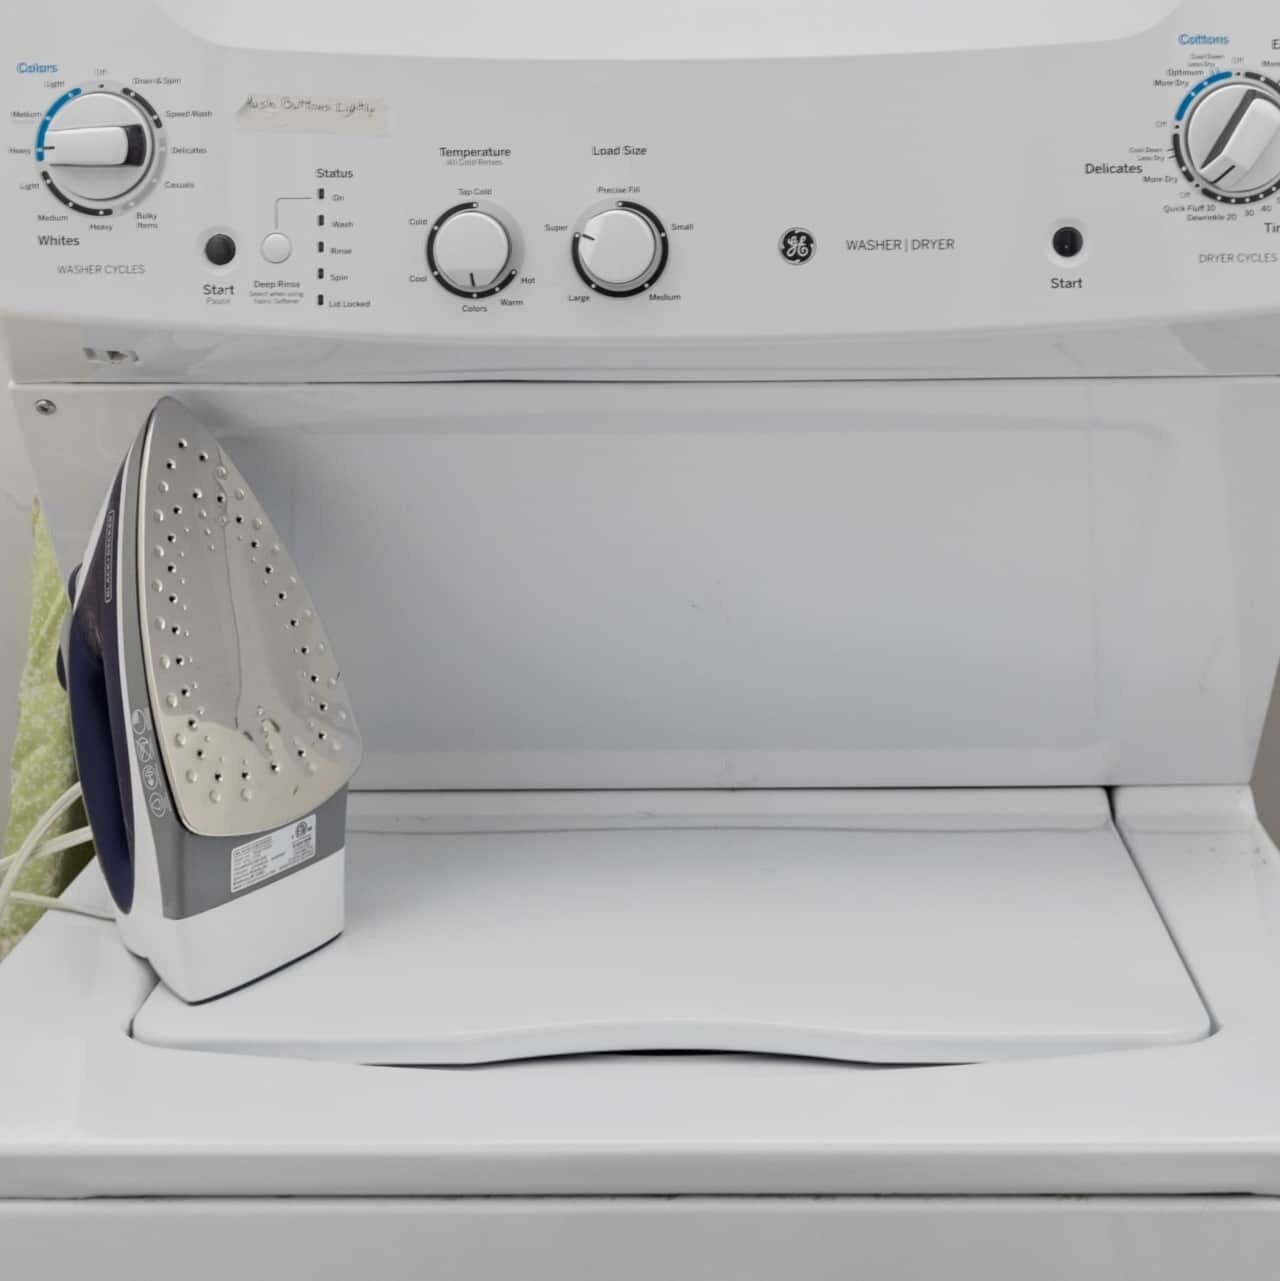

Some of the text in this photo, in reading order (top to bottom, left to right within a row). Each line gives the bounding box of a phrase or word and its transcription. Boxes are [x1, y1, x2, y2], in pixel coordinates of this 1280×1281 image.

[1178, 34, 1230, 45] Cottons
[17, 62, 58, 73] Colors
[440, 147, 511, 159] Temperature
[592, 145, 647, 156] Load Size
[316, 168, 354, 178] Status
[1085, 163, 1143, 174] Delicates
[1164, 176, 1178, 184] Dry
[544, 224, 568, 232] Super
[38, 235, 80, 246] Whites
[846, 238, 955, 251] WASHER DRYER
[1199, 253, 1278, 264] DRYER CYCLES
[57, 264, 146, 274] WASHER CYCLES
[330, 274, 348, 282] Spin
[1051, 278, 1082, 288] Start
[203, 284, 234, 295] Start
[254, 280, 300, 289] Deep Rinse
[568, 295, 591, 303] Large
[648, 293, 681, 301] Medium
